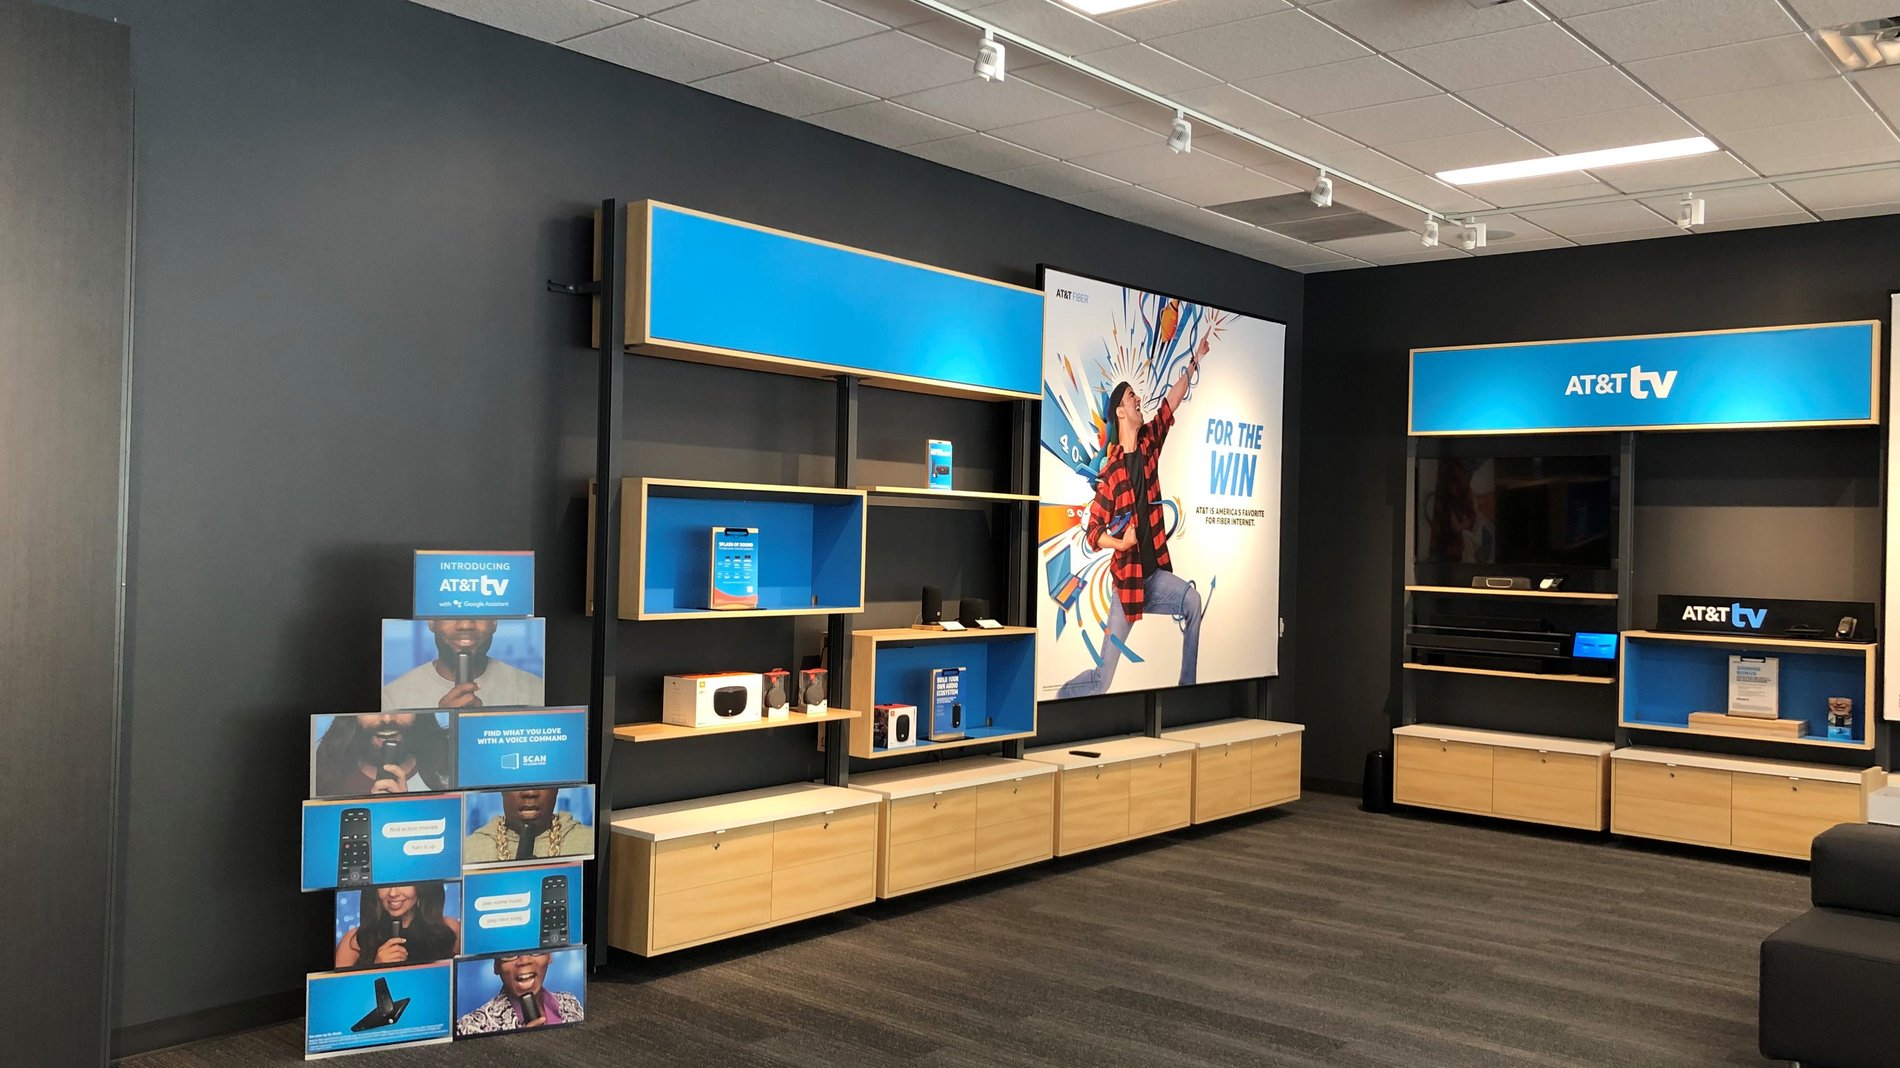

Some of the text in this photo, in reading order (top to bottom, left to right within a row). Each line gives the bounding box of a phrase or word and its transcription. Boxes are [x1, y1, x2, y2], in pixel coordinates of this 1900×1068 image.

[1056, 289, 1089, 304] AT&T FIBER
[1564, 365, 1678, 399] AT&T tv
[1206, 418, 1264, 450] FOR THE
[1210, 450, 1257, 497] WIN
[1196, 506, 1265, 518] AT&T IS AMERICA'S FAVORITE
[1217, 517, 1230, 525] FIBER
[440, 562, 511, 571] INTRODUCING
[439, 574, 509, 596] AT&T tv
[463, 600, 484, 608] Google
[1682, 602, 1768, 629] AT&T tv
[529, 734, 567, 742] COMMAND
[522, 755, 547, 763] SCAN
